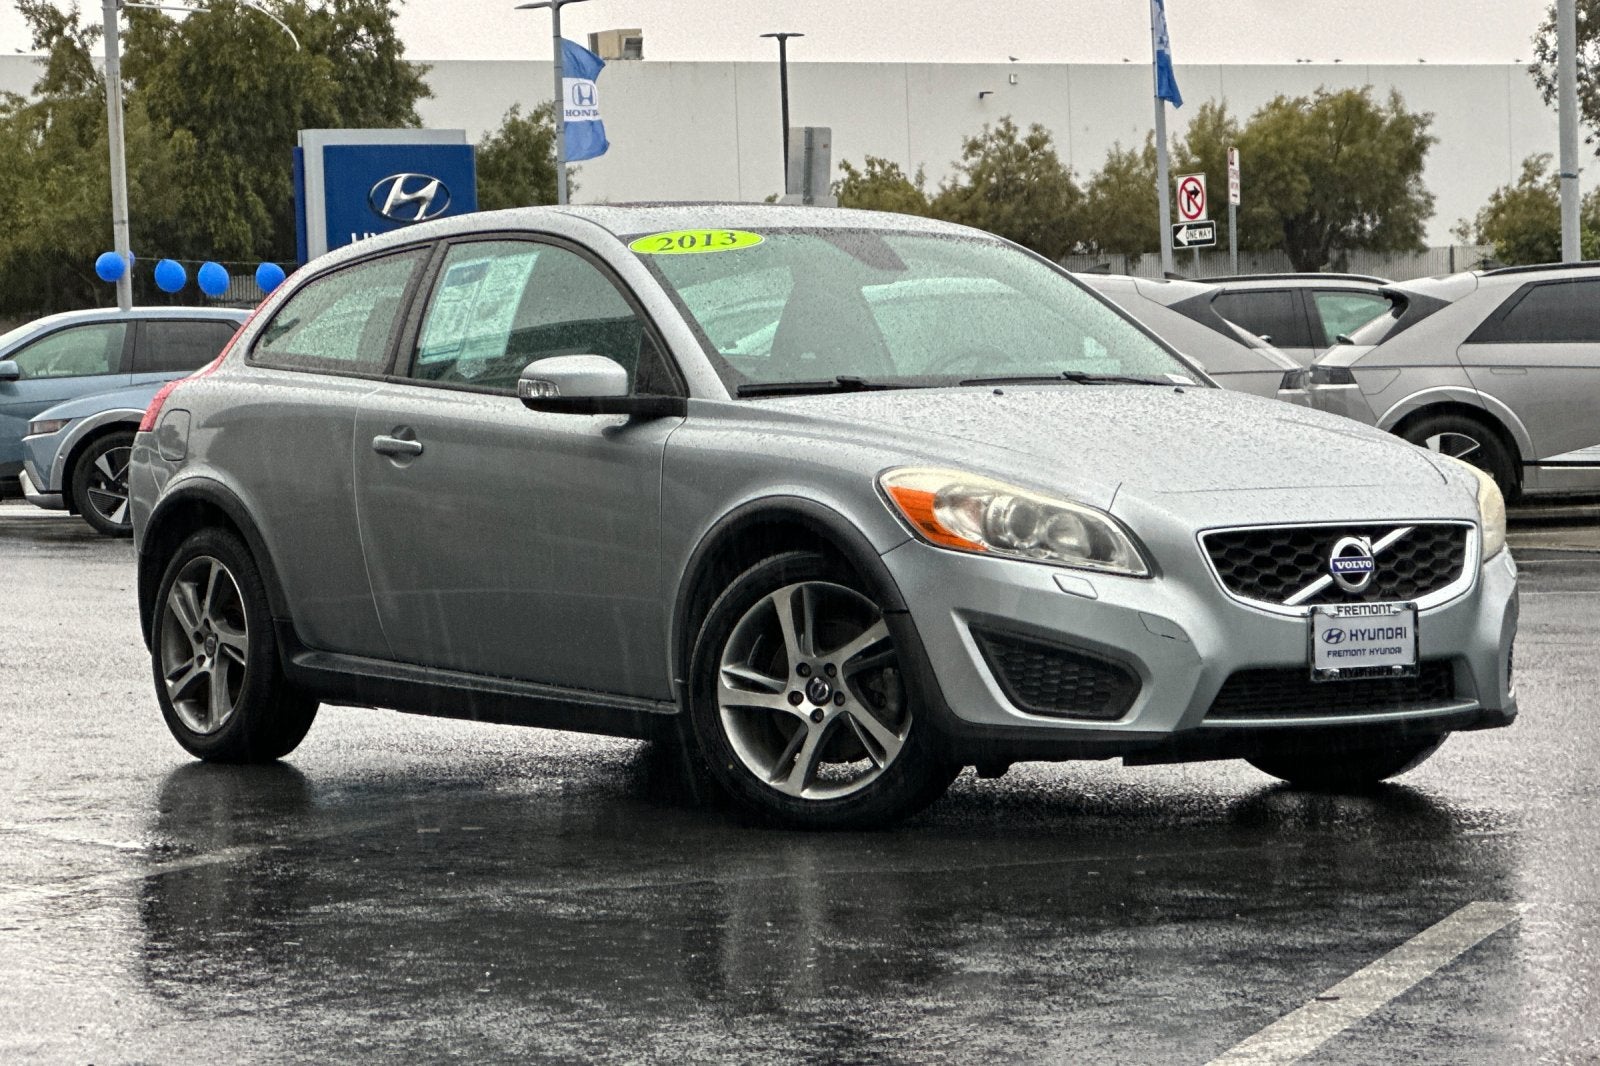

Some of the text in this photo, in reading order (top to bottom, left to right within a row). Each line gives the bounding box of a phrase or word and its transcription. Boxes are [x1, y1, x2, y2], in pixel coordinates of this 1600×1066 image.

[1185, 228, 1211, 240] ONE WAY
[656, 232, 737, 251] 2013
[1335, 560, 1372, 569] VOLVO
[1336, 604, 1393, 615] FREMONT
[1349, 627, 1407, 641] HYUNDAI
[1327, 646, 1402, 658] FREMONT HYUNDAI
